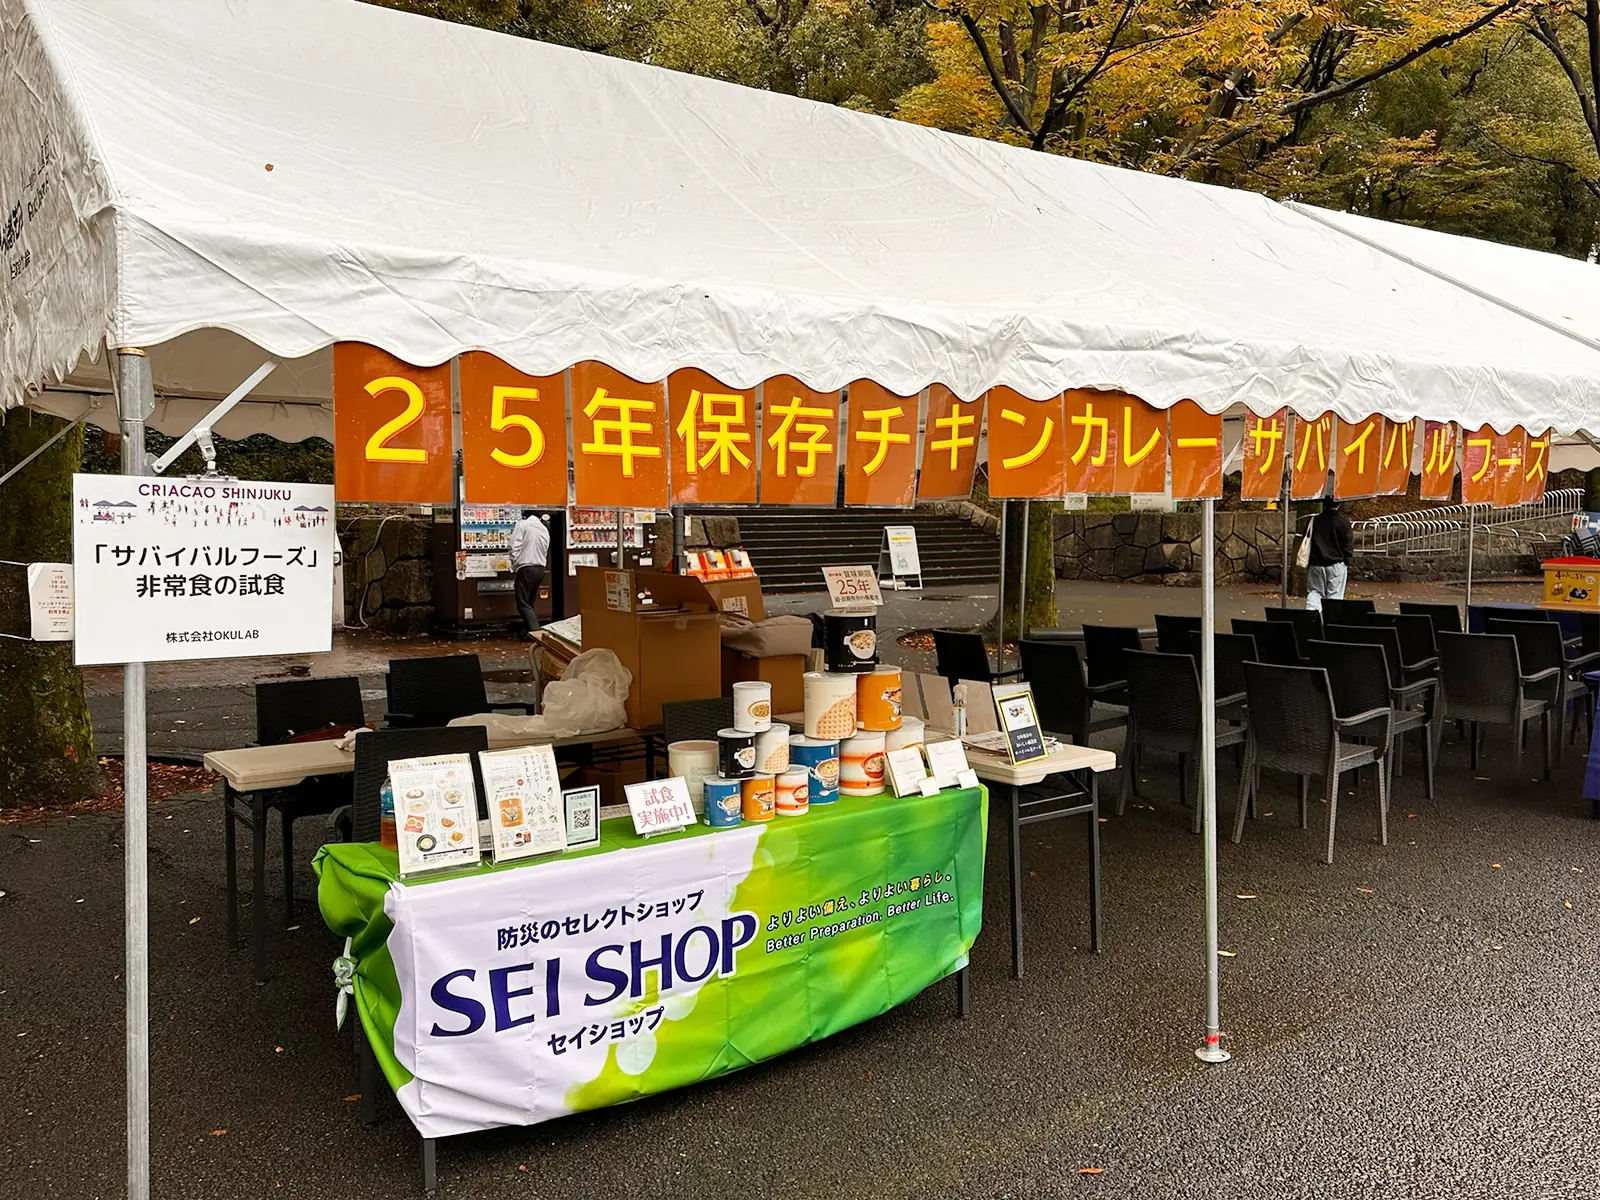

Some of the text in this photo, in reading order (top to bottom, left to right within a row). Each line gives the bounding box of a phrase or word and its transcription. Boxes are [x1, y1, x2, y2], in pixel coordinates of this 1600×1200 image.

[138, 484, 292, 501] CRIACAO SHINJUKU
[93, 543, 320, 568] 「サバイバルフーズ」
[135, 573, 286, 598] 非常食の試食
[836, 579, 871, 595] 25年
[165, 628, 260, 644] 株式会社OKULAB
[642, 786, 675, 807] 試食
[497, 890, 705, 951] 防災のセレクトショップ
[766, 931, 805, 953] Better
[886, 898, 922, 917] Better
[925, 891, 954, 906] Life.
[430, 911, 758, 1039] SEI SHOP
[547, 1006, 665, 1056] セイショップ
